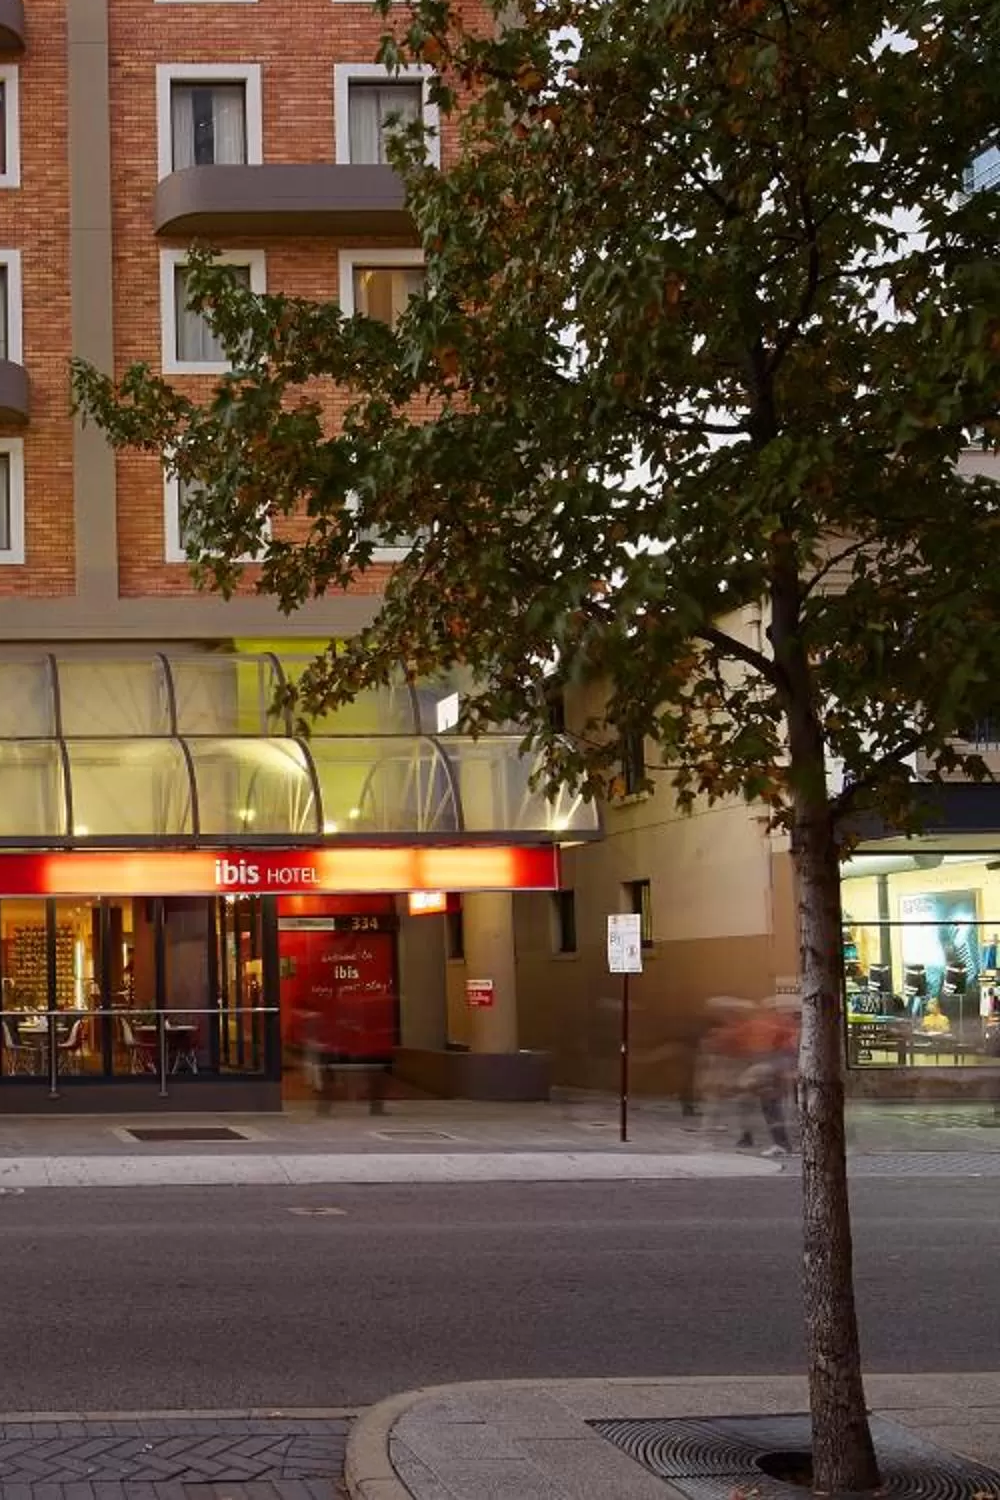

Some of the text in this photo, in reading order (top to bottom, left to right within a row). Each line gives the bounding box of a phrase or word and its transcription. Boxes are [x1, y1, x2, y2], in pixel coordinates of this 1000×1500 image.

[215, 860, 321, 885] ibis HOTEL
[351, 917, 379, 931] 334
[334, 966, 360, 979] ibis
